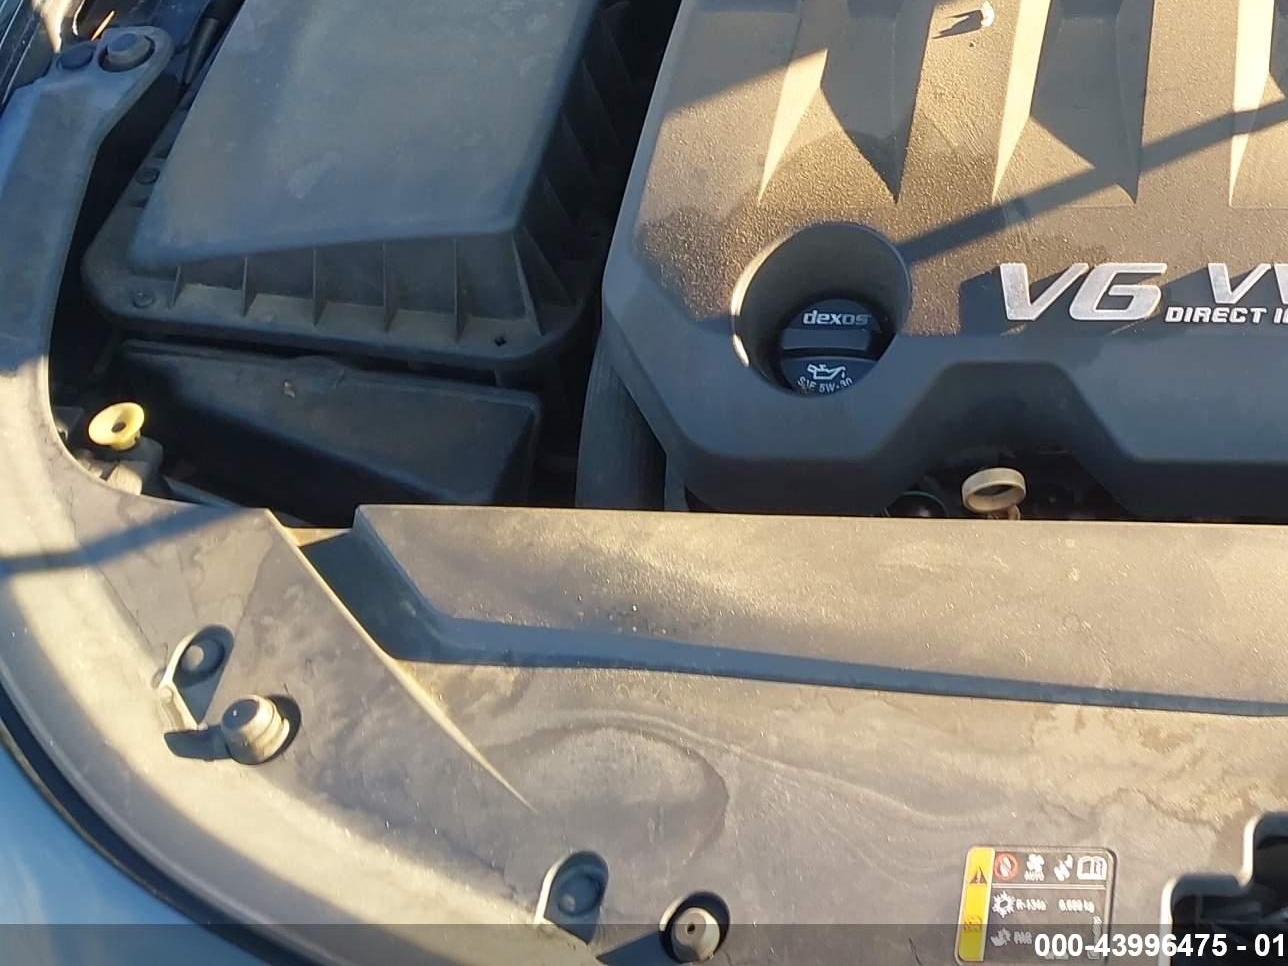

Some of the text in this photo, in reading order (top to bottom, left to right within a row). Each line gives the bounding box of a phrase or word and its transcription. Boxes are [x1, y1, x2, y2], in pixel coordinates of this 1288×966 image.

[1000, 262, 1168, 320] V6
[803, 310, 871, 325] dexos
[1165, 306, 1267, 324] DIRECT
